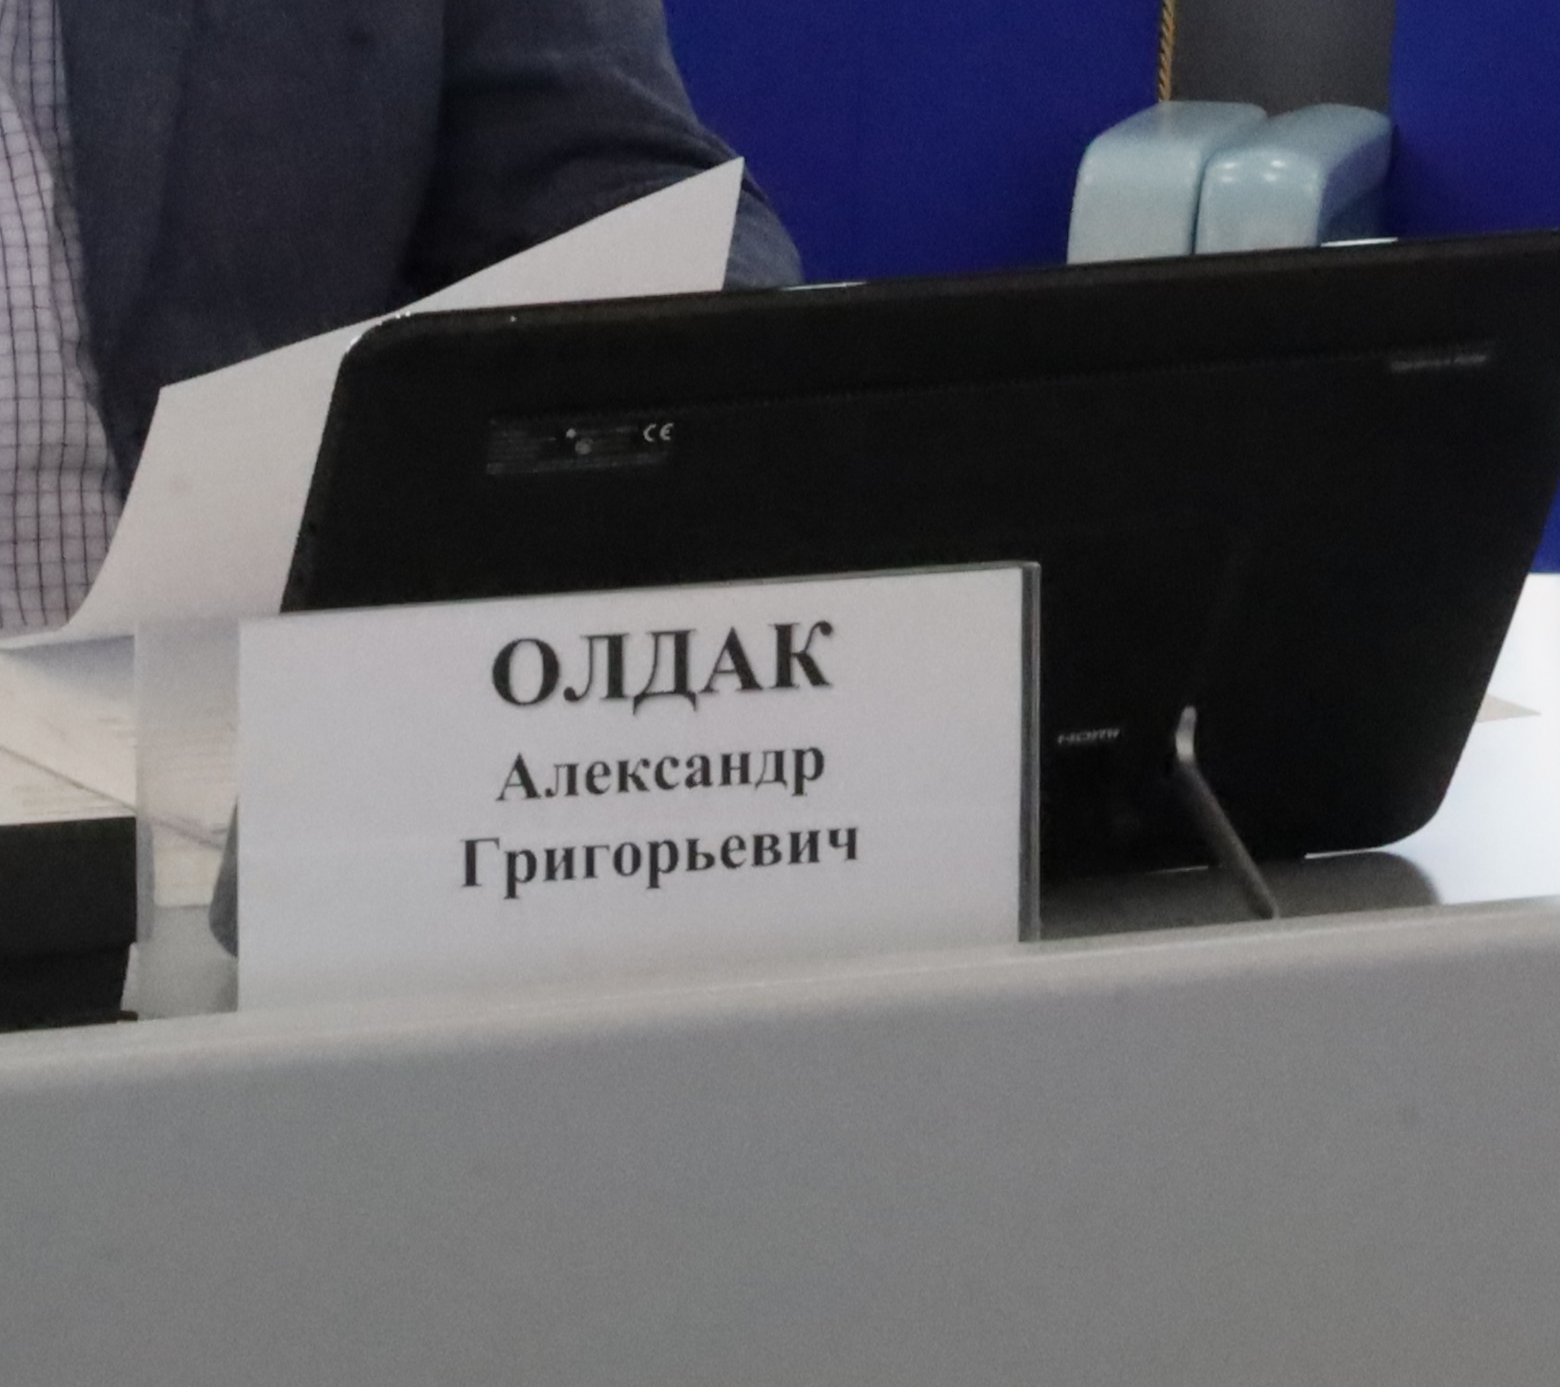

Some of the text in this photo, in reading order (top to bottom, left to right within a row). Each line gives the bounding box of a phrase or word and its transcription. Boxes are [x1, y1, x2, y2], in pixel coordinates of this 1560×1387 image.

[491, 620, 834, 716] ОЛДАК
[496, 746, 825, 802] Александр
[463, 827, 858, 900] Григорьевич
